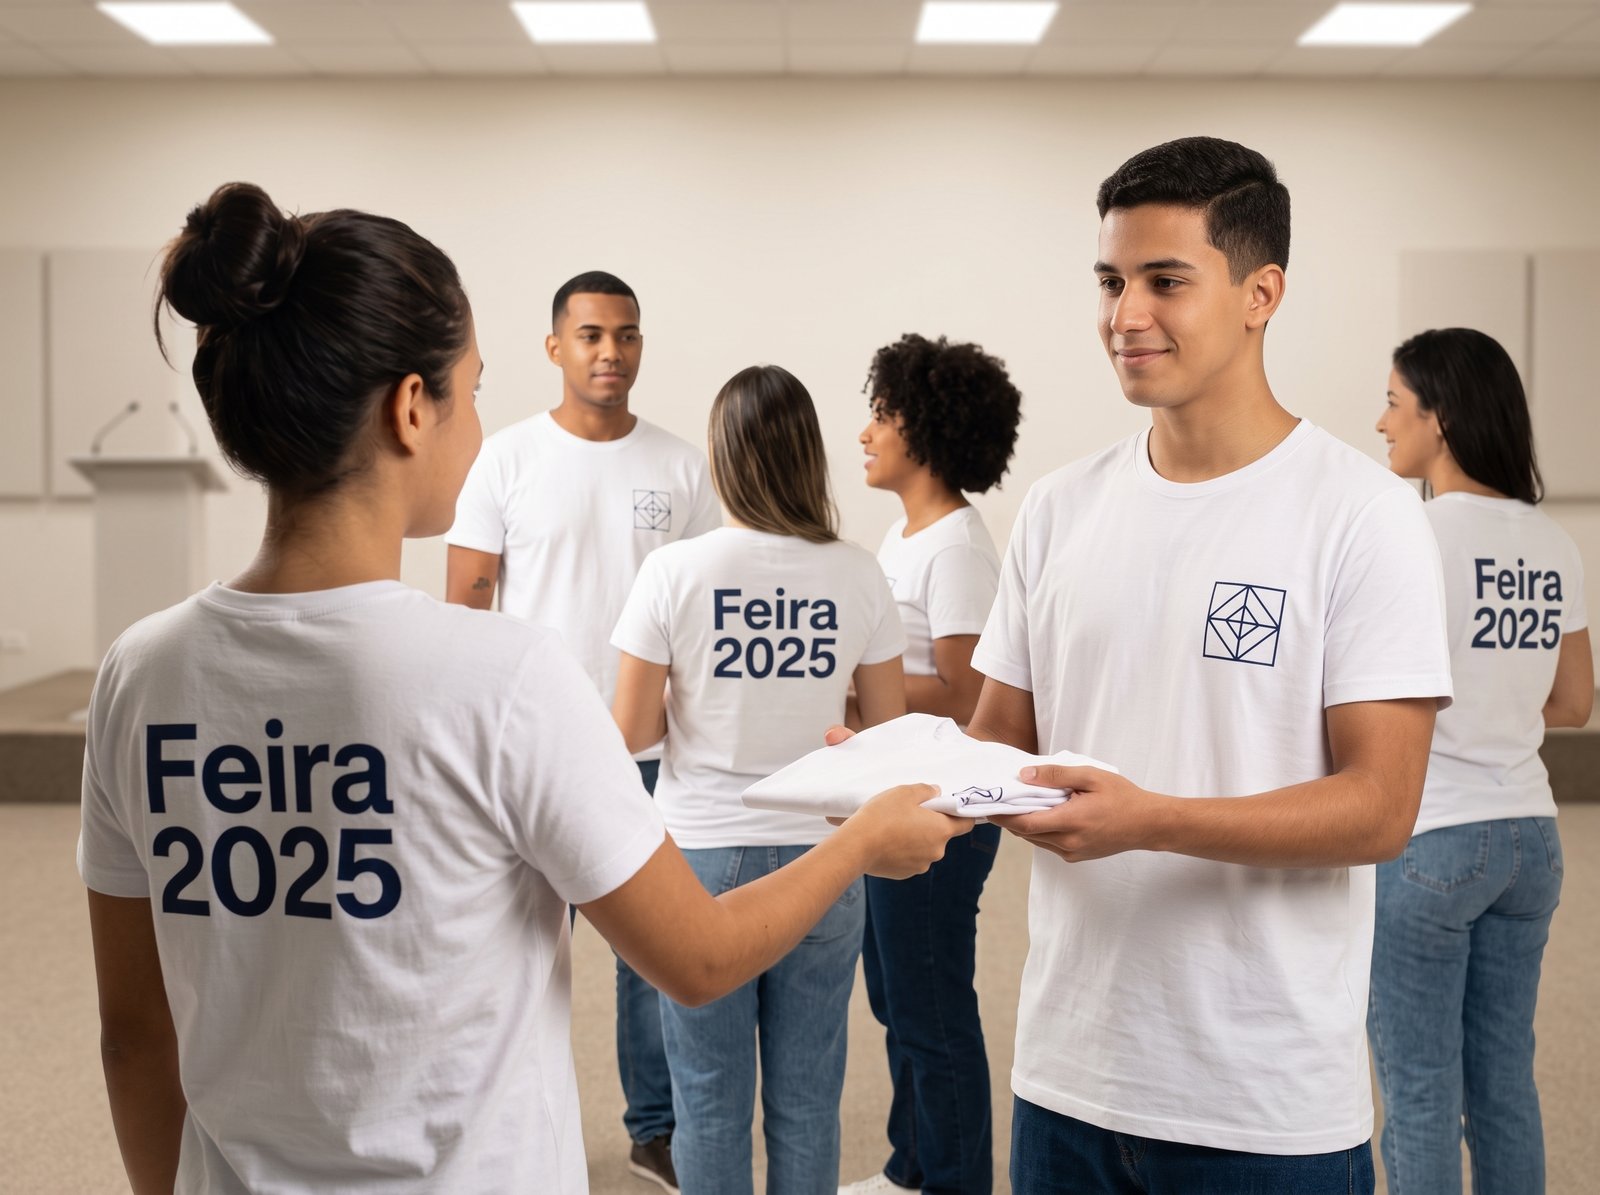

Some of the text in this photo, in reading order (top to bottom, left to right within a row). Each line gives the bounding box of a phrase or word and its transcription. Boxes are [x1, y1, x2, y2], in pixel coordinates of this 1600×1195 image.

[1475, 558, 1563, 602] Feira
[713, 587, 838, 632] Feira
[1472, 606, 1561, 650] 2025
[713, 637, 837, 680] 2025
[146, 718, 394, 815] Feira
[153, 826, 402, 919] 2025
